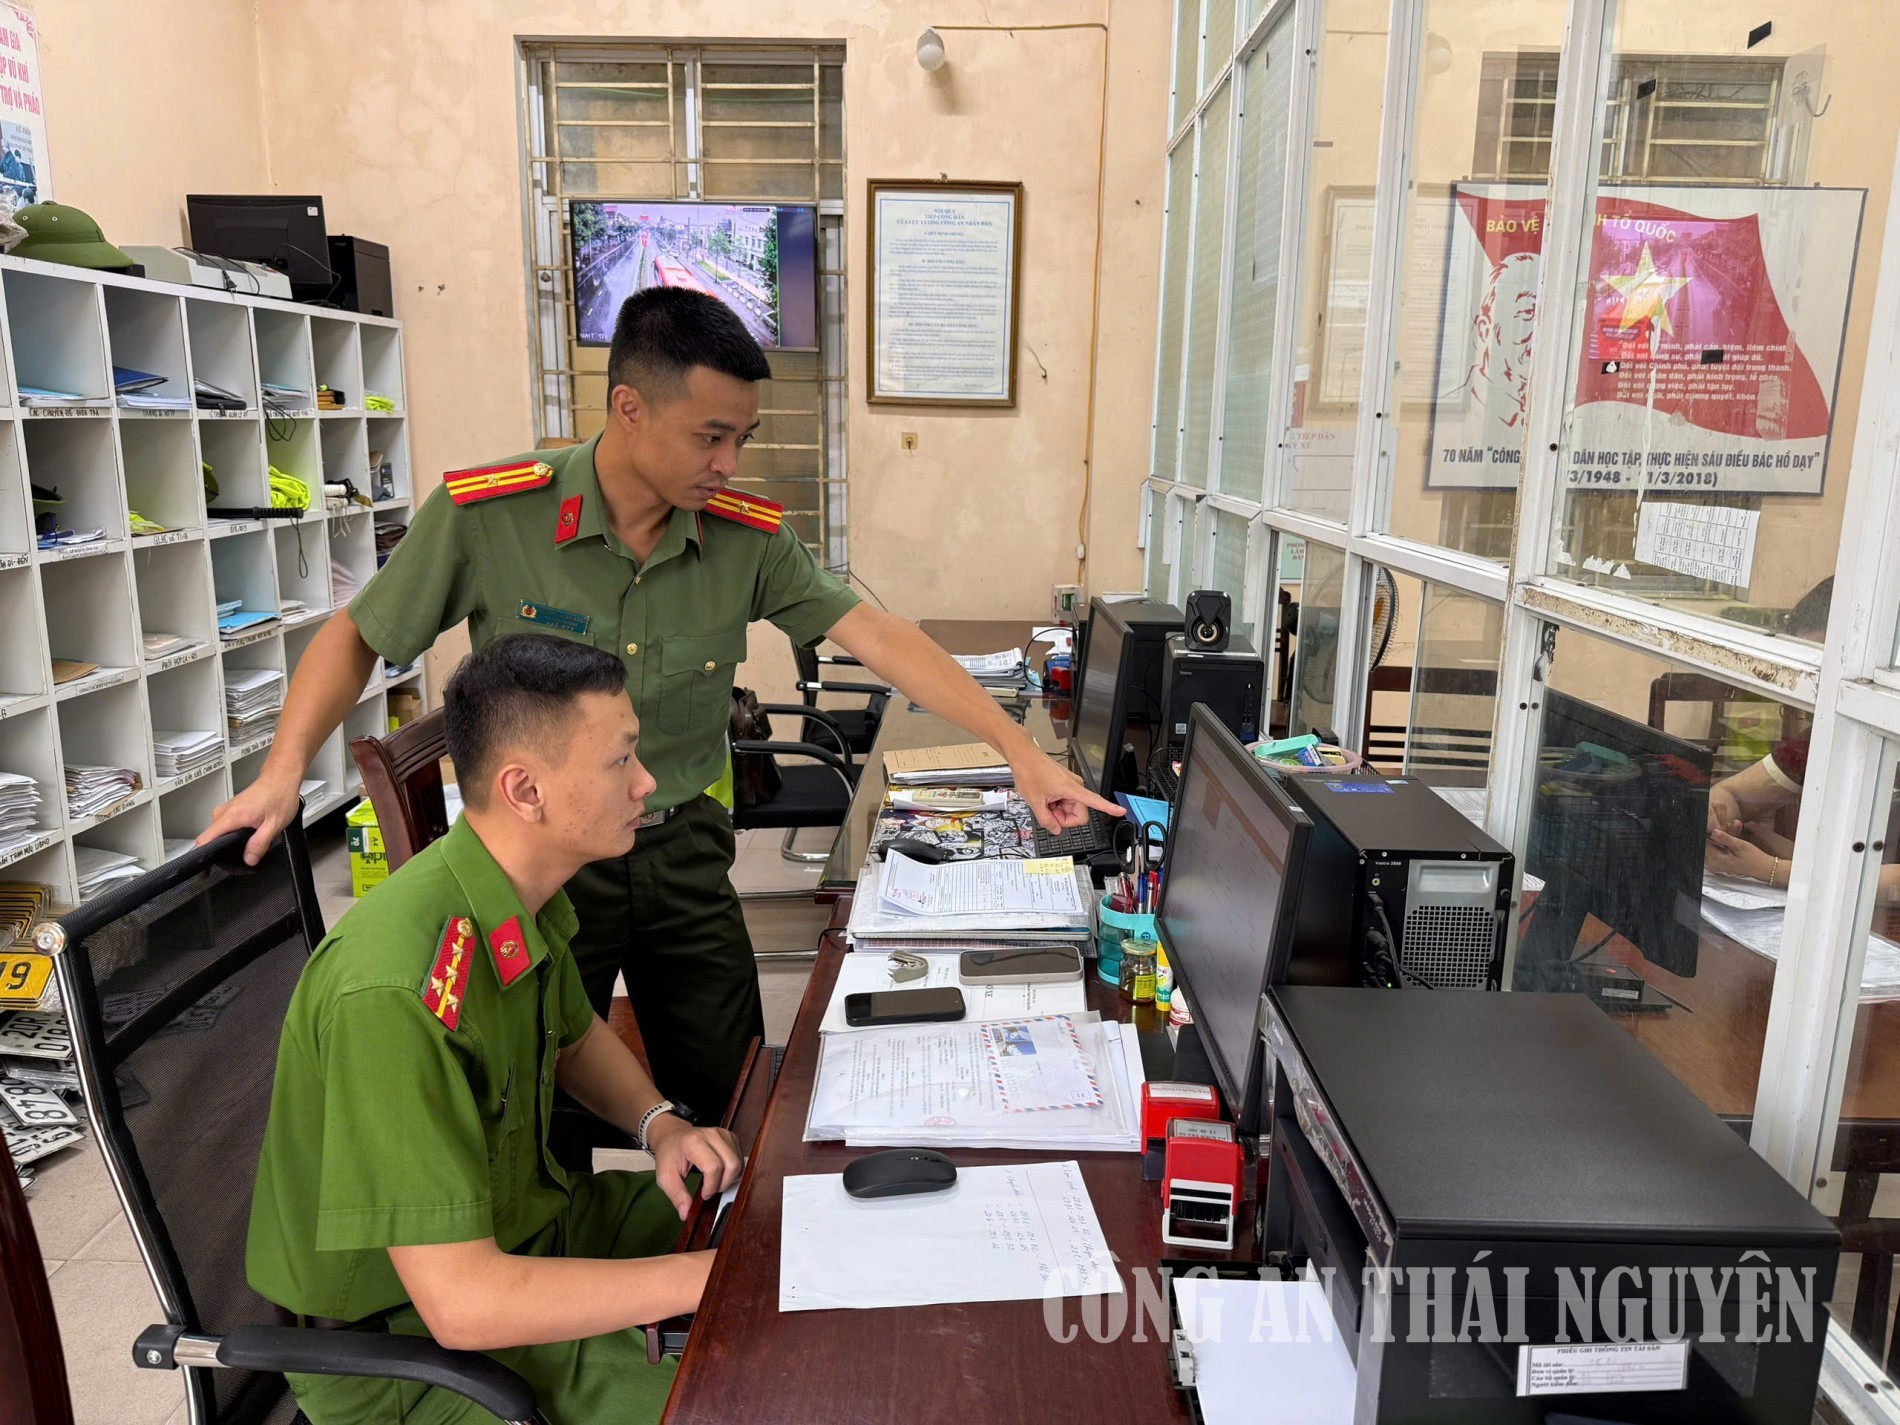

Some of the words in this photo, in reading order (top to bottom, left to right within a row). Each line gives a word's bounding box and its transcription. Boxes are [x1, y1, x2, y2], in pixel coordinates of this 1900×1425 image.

[11, 30, 22, 53] GIA
[8, 56, 17, 79] VŨ
[18, 60, 30, 84] KHÍ
[13, 88, 23, 110] VÀ
[23, 91, 41, 115] PHÁO
[1486, 214, 1517, 233] BẢO
[1521, 215, 1540, 235] VỆ
[1612, 209, 1631, 230] TỔ
[1634, 221, 1677, 243] QUỐC
[1443, 449, 1456, 463] 70
[1458, 447, 1483, 463] NĂM
[1572, 449, 1596, 465] DÂN
[1597, 451, 1619, 469] HỌC
[1674, 449, 1699, 470] HIỆN
[1701, 450, 1722, 467] SÁU
[1725, 449, 1750, 468] ĐIỀU
[1752, 450, 1773, 468] BÁC
[1775, 449, 1791, 469] HỒ
[371, 836, 379, 847] A4
[1594, 1345, 1618, 1353] THÔNG
